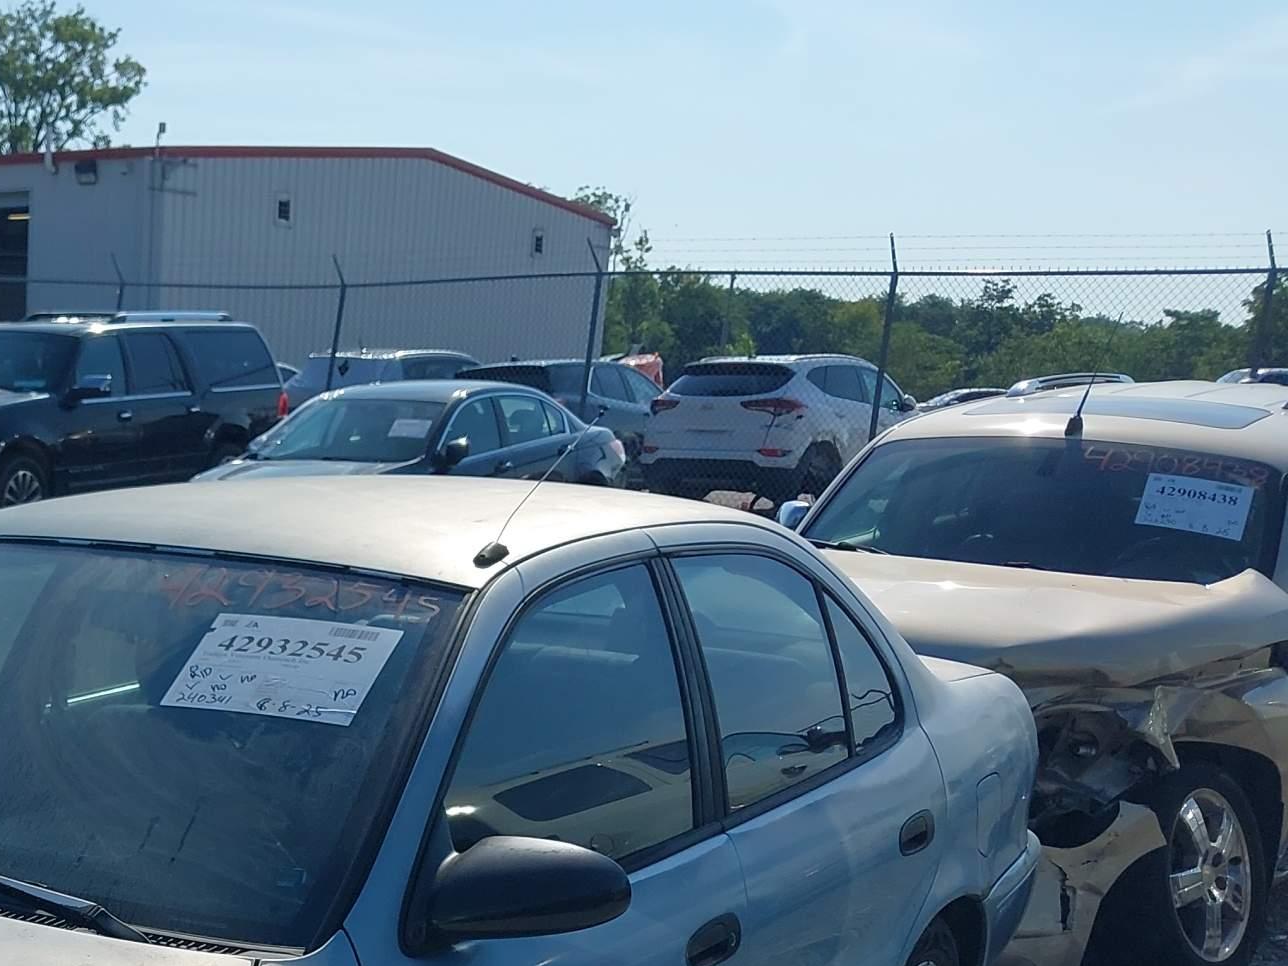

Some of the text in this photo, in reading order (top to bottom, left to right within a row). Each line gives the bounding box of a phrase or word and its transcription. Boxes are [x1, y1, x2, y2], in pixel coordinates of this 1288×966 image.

[1155, 486, 1239, 506] 42908438
[160, 563, 441, 621] 42932545
[217, 635, 368, 664] 42932545
